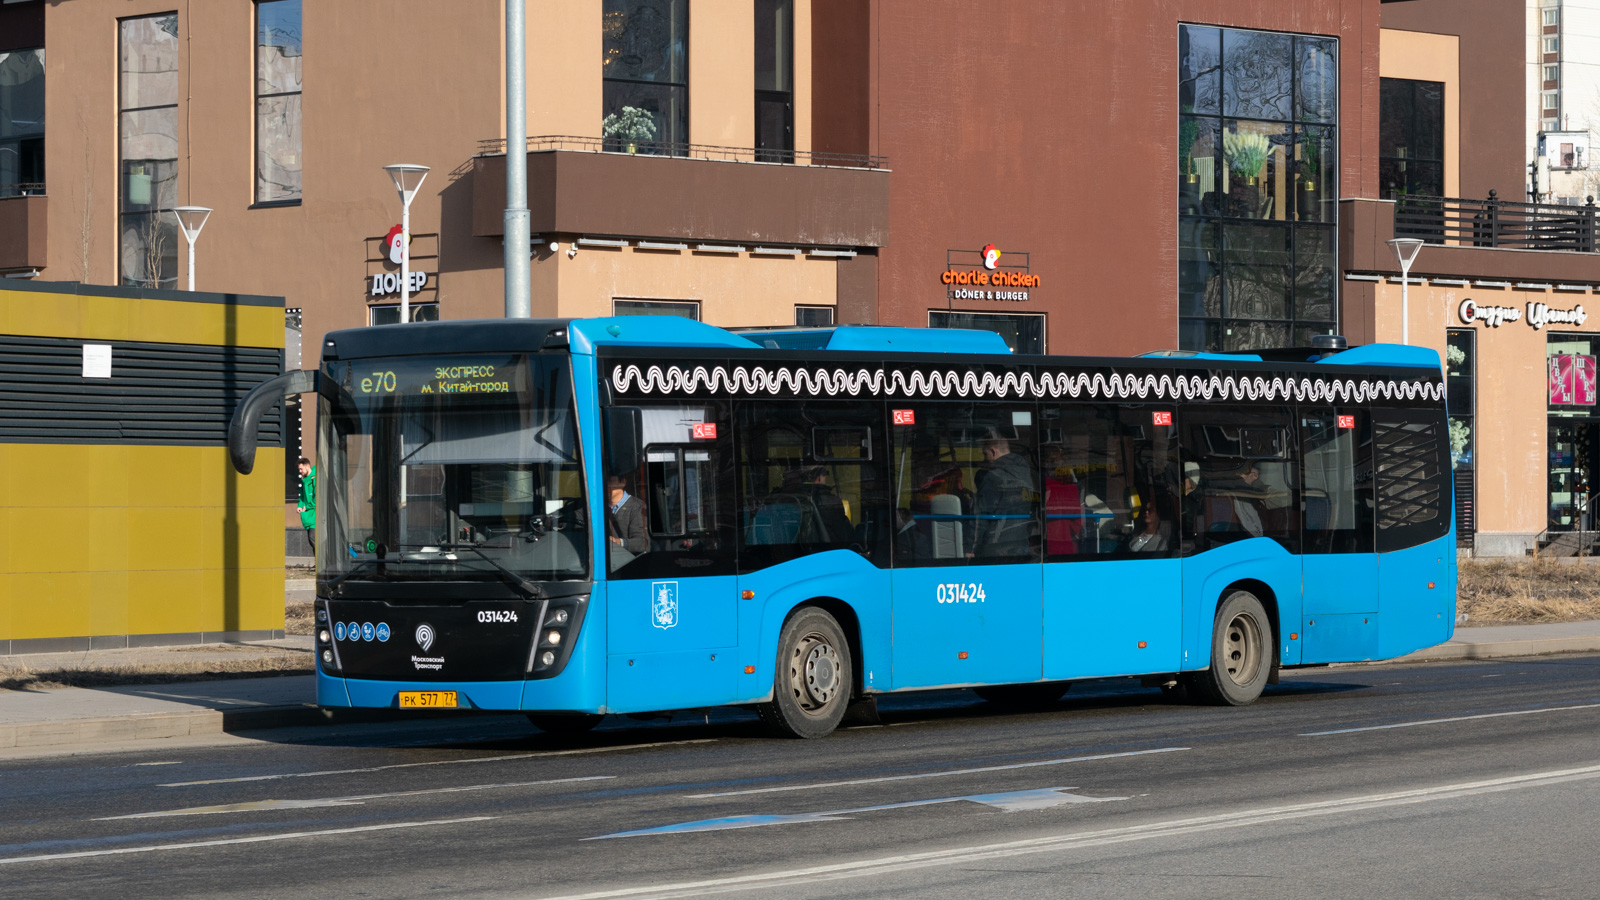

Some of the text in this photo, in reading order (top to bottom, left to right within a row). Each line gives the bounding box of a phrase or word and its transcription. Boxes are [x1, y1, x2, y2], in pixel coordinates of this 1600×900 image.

[942, 269, 1041, 287] charlie chicken
[955, 288, 1028, 301] DÖNER & BURGER
[1460, 299, 1588, 329] Студия Цветов
[434, 365, 495, 380] ЭКСПРЕСС
[420, 380, 510, 394] м. Китай-город
[1552, 358, 1571, 402] ЦВЕТЫ
[1576, 358, 1594, 402] ШАРЫ
[936, 583, 986, 604] 031424
[477, 610, 518, 623] 031424
[411, 655, 445, 663] Московский
[414, 662, 442, 671] Транспорт
[420, 693, 438, 706] 577
[443, 692, 454, 702] 77
